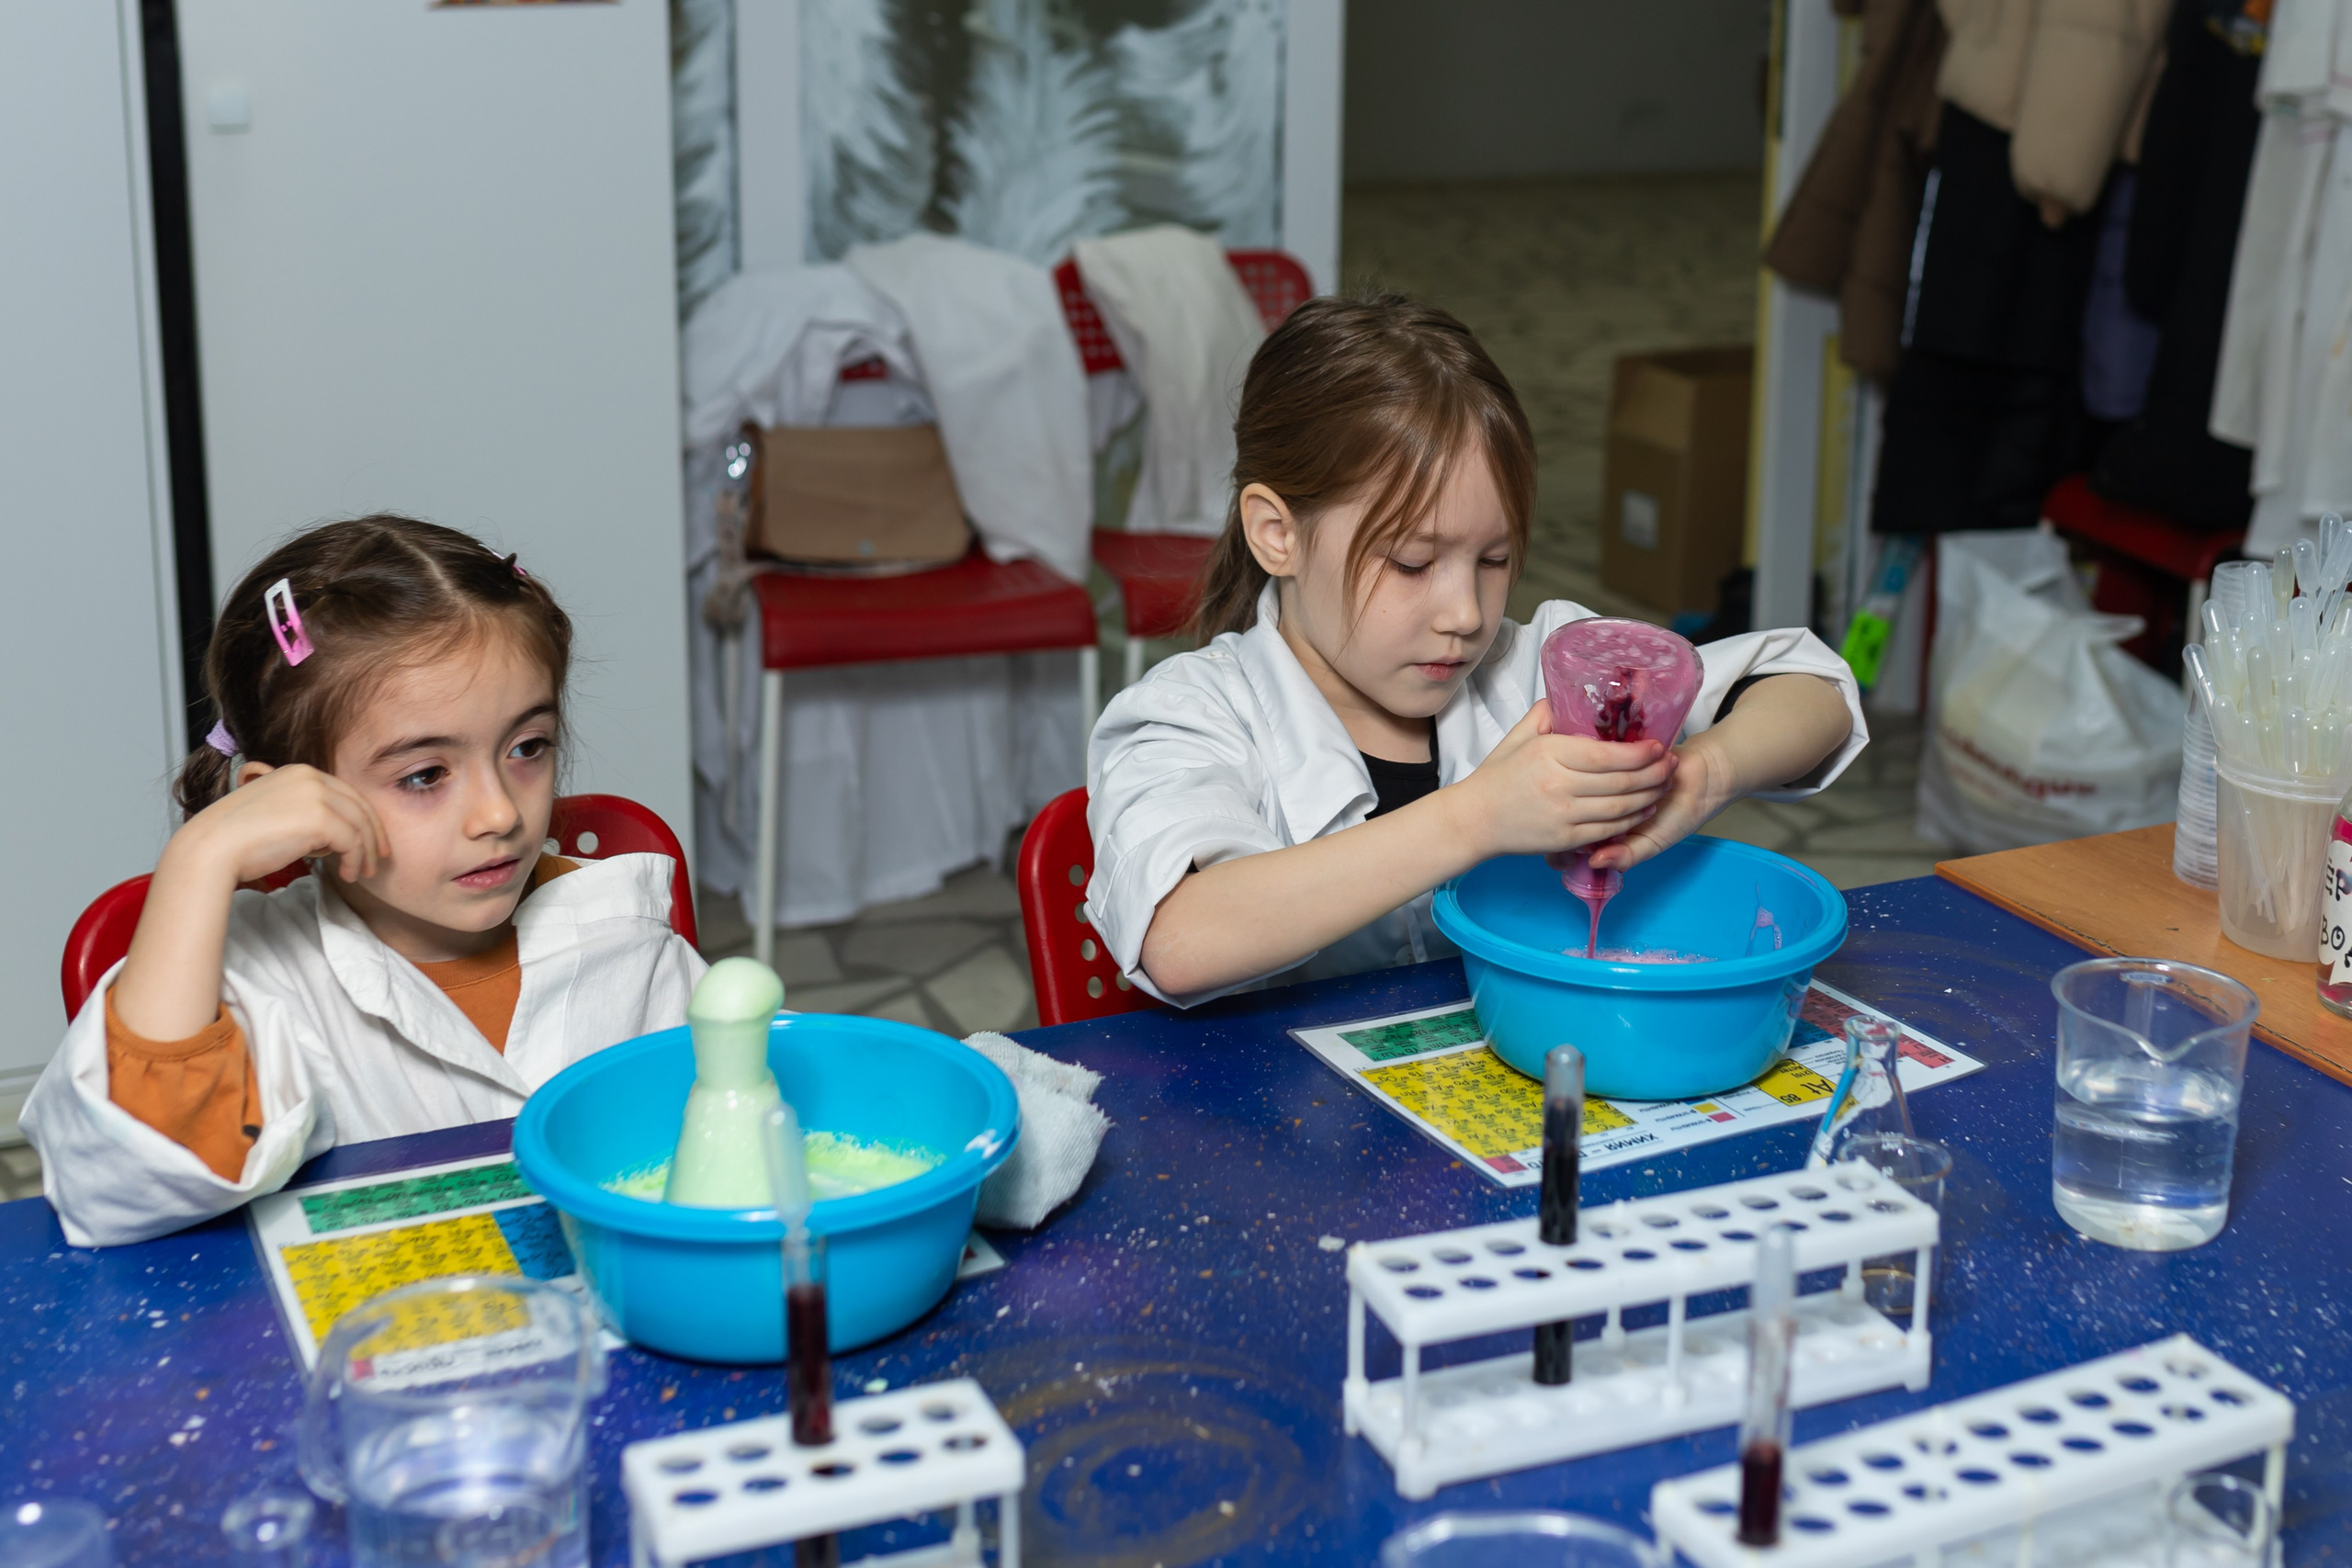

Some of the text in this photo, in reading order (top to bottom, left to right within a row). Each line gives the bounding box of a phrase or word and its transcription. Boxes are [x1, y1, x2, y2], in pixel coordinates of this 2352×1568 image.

[1800, 1079, 1835, 1095] At
[1780, 1093, 1802, 1103] 85
[1603, 1133, 1659, 1151] ХИМИЯ
